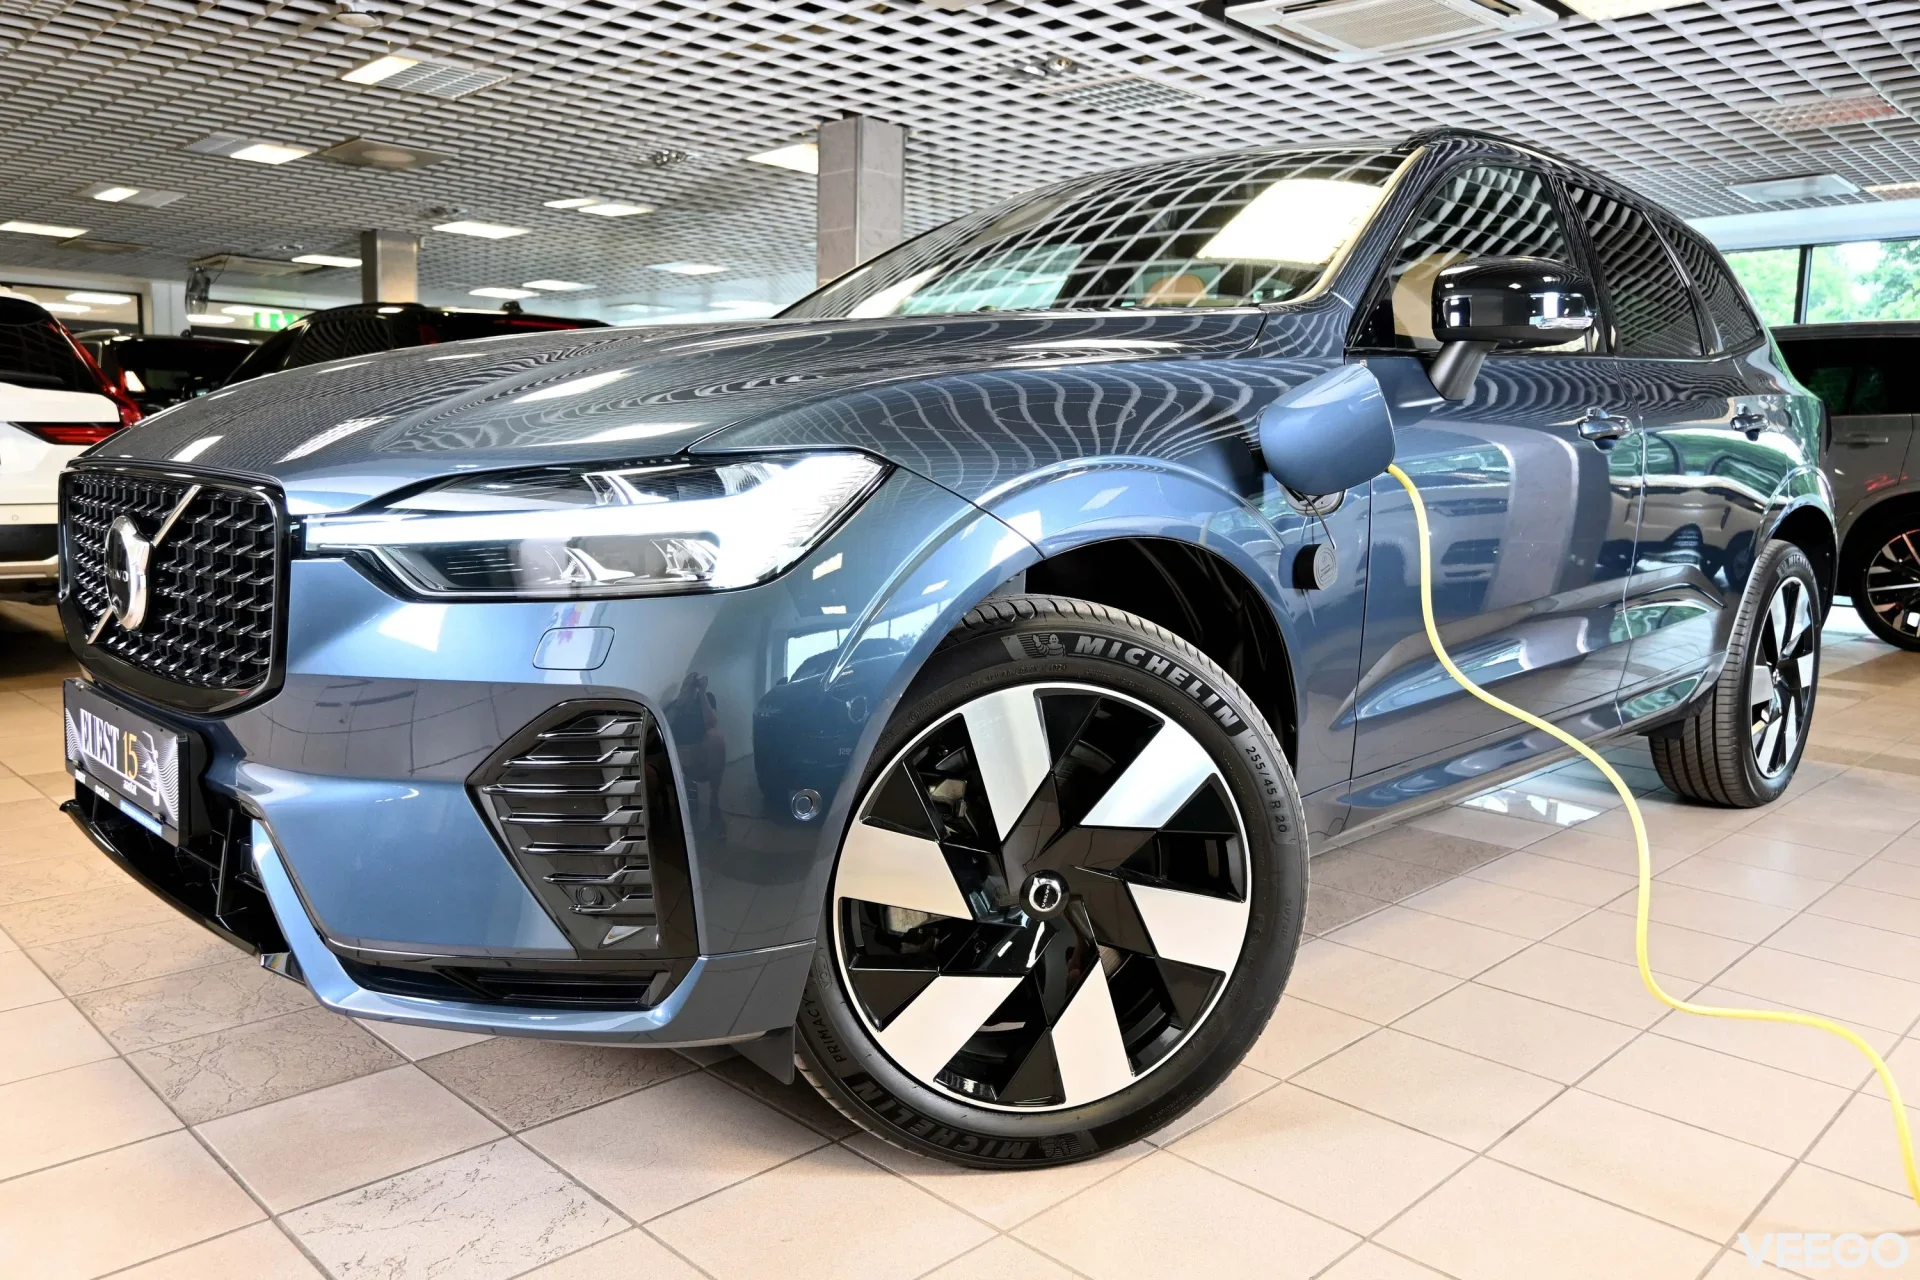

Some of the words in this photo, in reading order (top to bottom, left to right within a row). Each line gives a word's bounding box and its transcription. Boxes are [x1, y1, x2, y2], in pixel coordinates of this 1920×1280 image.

[1074, 634, 1240, 728] MICHELIN
[123, 730, 138, 780] 15
[1245, 745, 1278, 796] 255/45
[1270, 800, 1281, 810] R
[1275, 815, 1287, 833] 20
[804, 999, 847, 1064] PRIMACY
[850, 1080, 1031, 1159] MICHELIN
